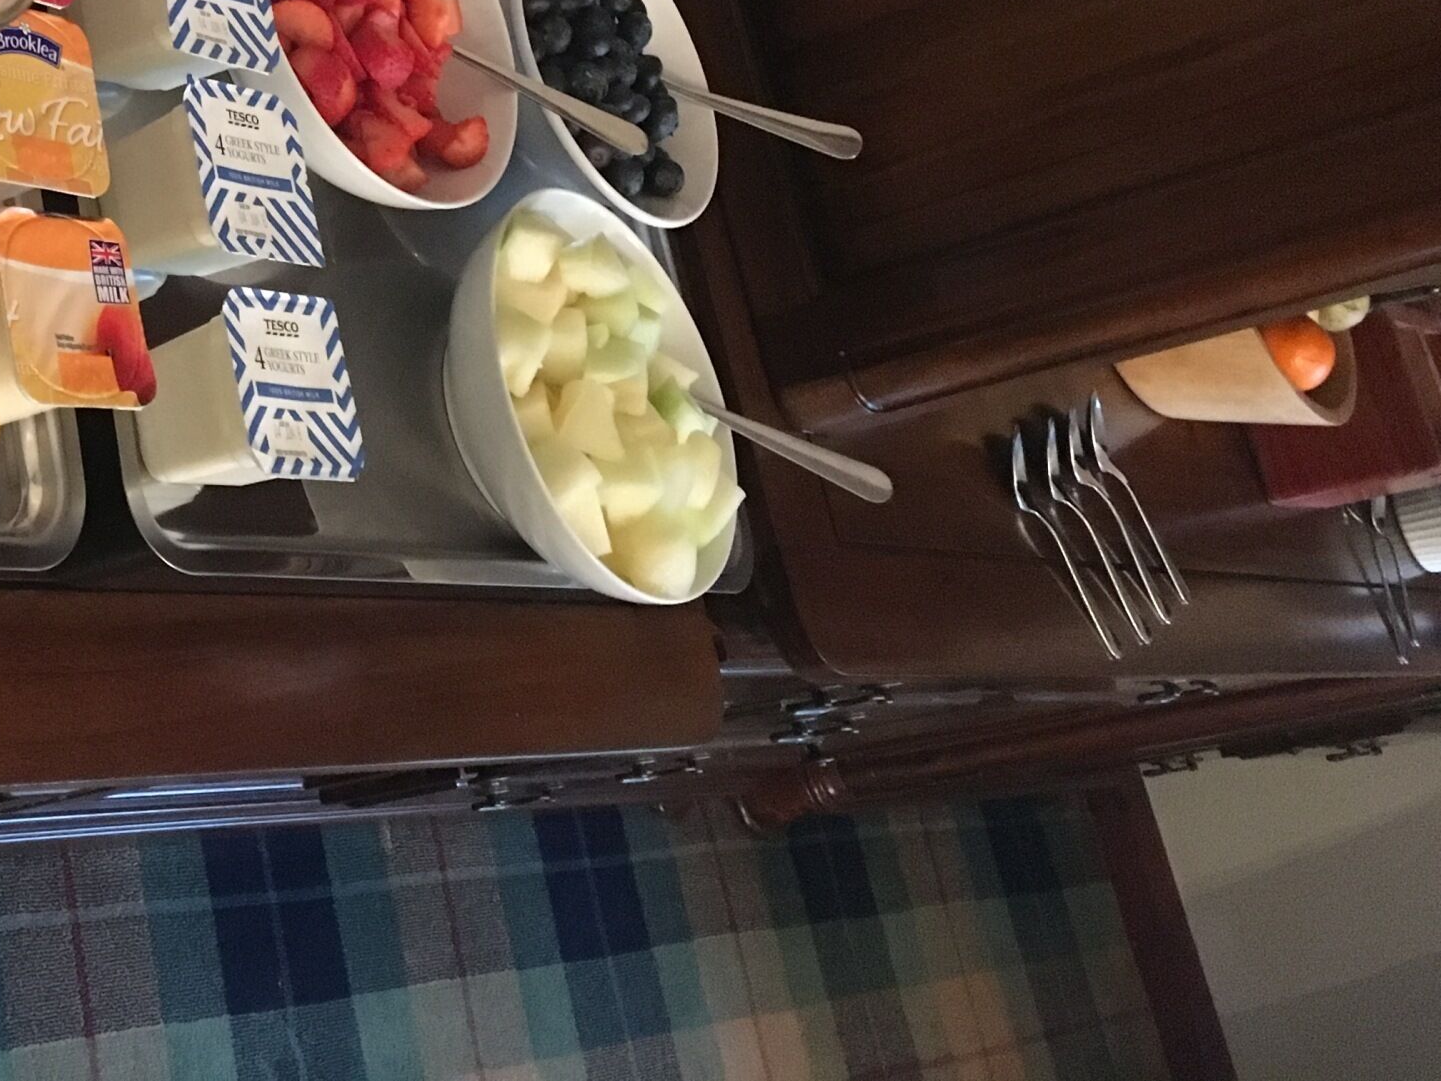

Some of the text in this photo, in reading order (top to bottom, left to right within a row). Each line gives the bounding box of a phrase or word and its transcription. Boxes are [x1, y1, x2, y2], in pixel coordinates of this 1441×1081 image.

[226, 108, 259, 126] TESCO
[215, 133, 280, 156] 4 GREEK STYLE
[227, 146, 267, 165] YOGURTS
[97, 286, 130, 303] MILK
[264, 318, 299, 333] TESCO
[254, 345, 320, 370] 4 GREEK STYLE
[267, 360, 306, 375] YOGURTS
